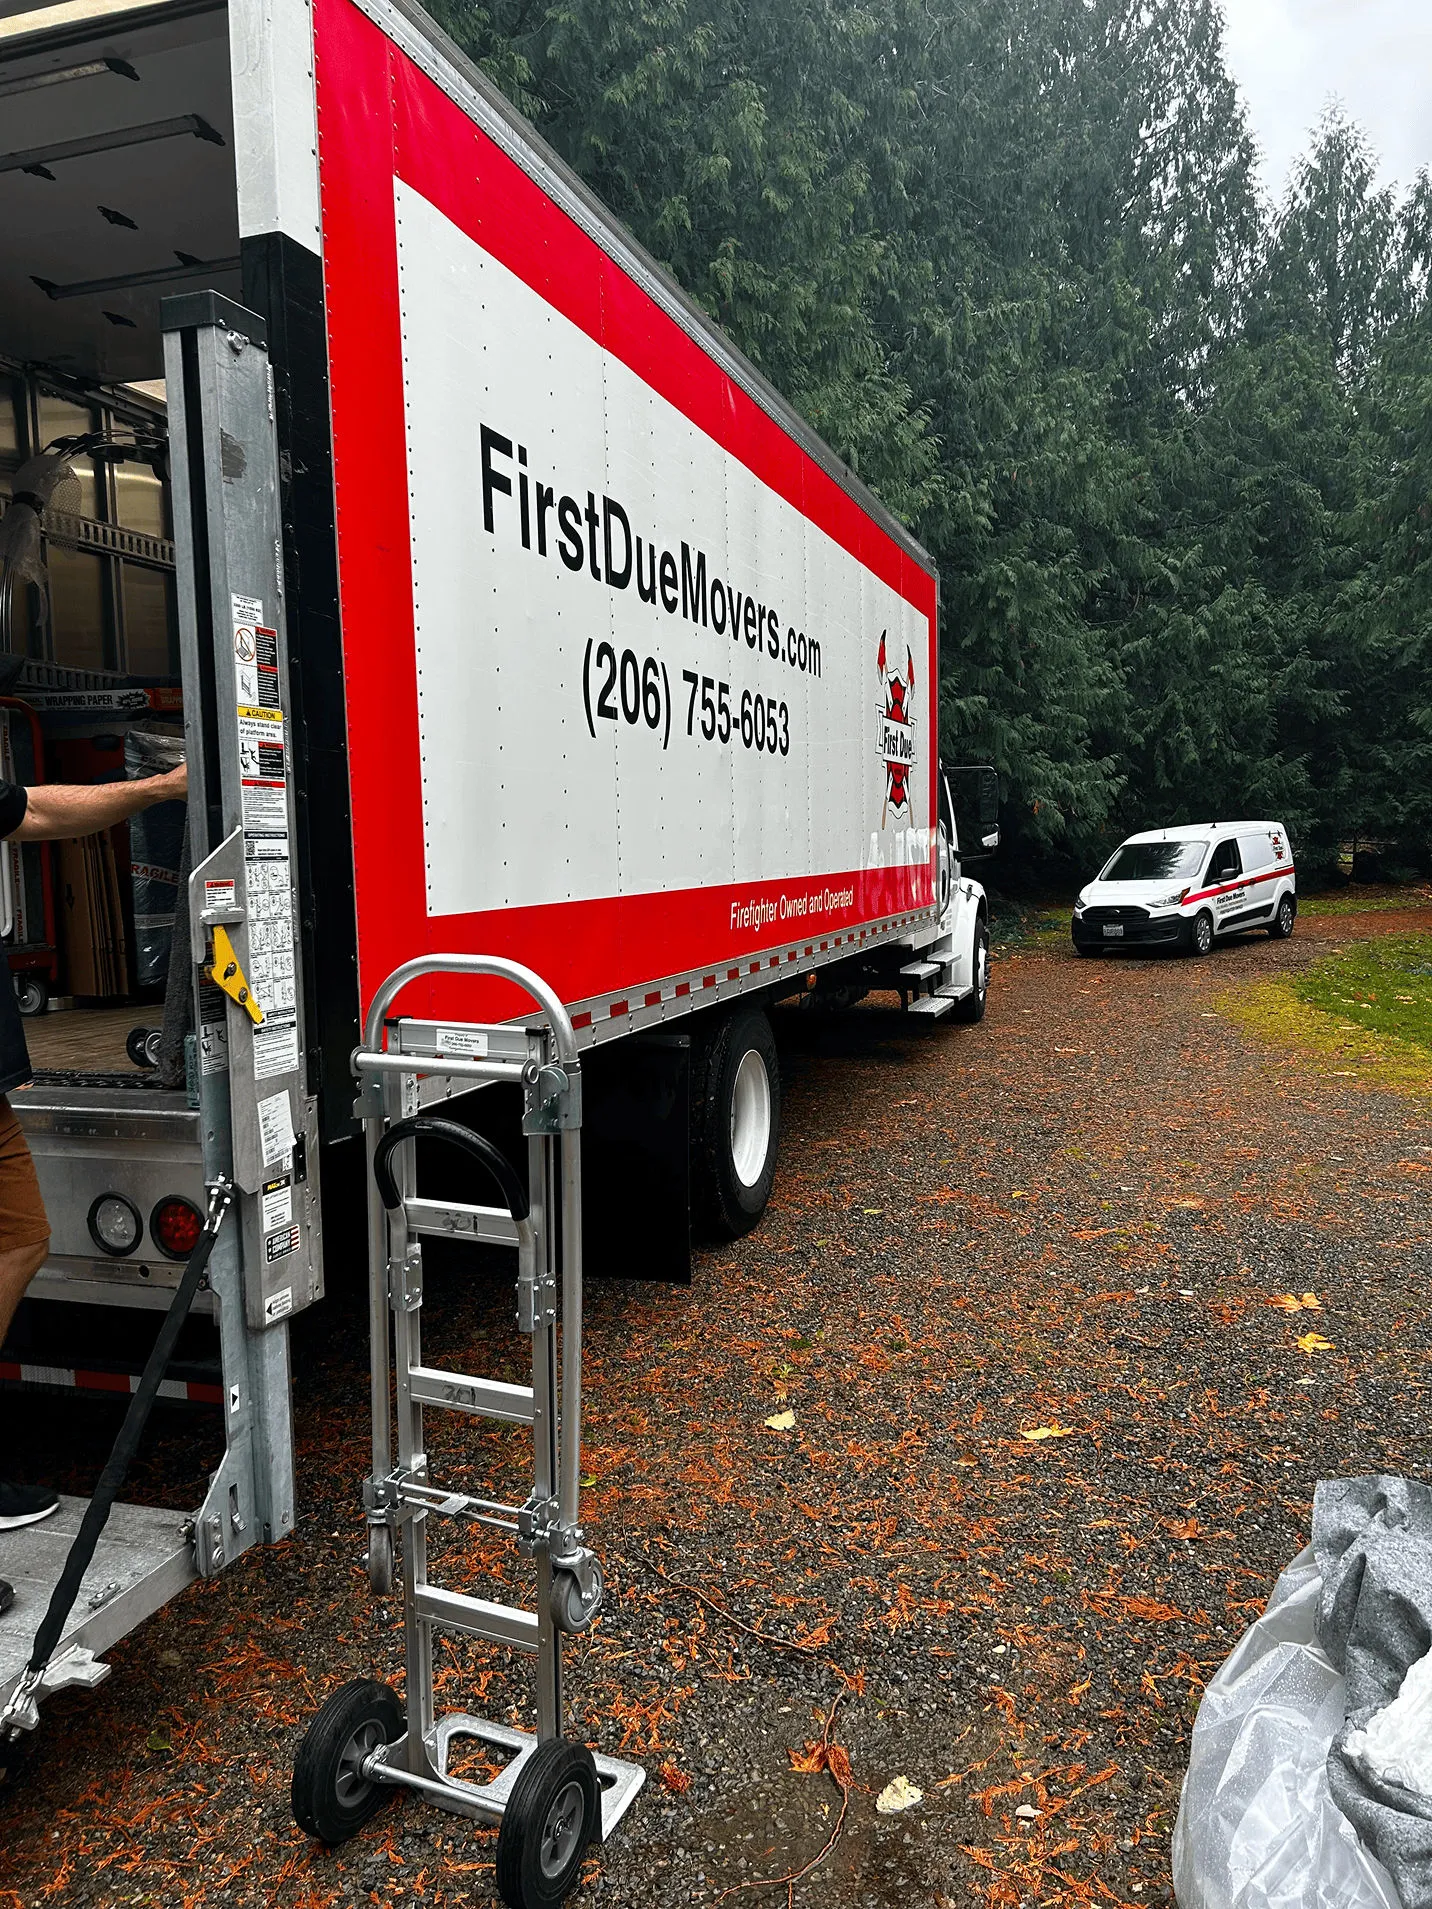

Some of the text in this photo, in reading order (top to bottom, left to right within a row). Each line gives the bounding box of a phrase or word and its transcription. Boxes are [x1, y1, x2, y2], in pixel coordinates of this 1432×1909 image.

[480, 423, 822, 678] FirstDueMovers.com
[45, 695, 86, 707] WRAPPING
[88, 694, 113, 706] PAPER
[583, 637, 790, 756] (206) 755-6053
[240, 719, 256, 728] Always
[252, 709, 276, 719] CAUTION
[883, 725, 912, 760] First Due
[131, 862, 180, 884] RAGILE
[730, 885, 854, 932] Firefighter Owned and Operated
[1216, 896, 1226, 904] First
[1232, 891, 1246, 900] Movers
